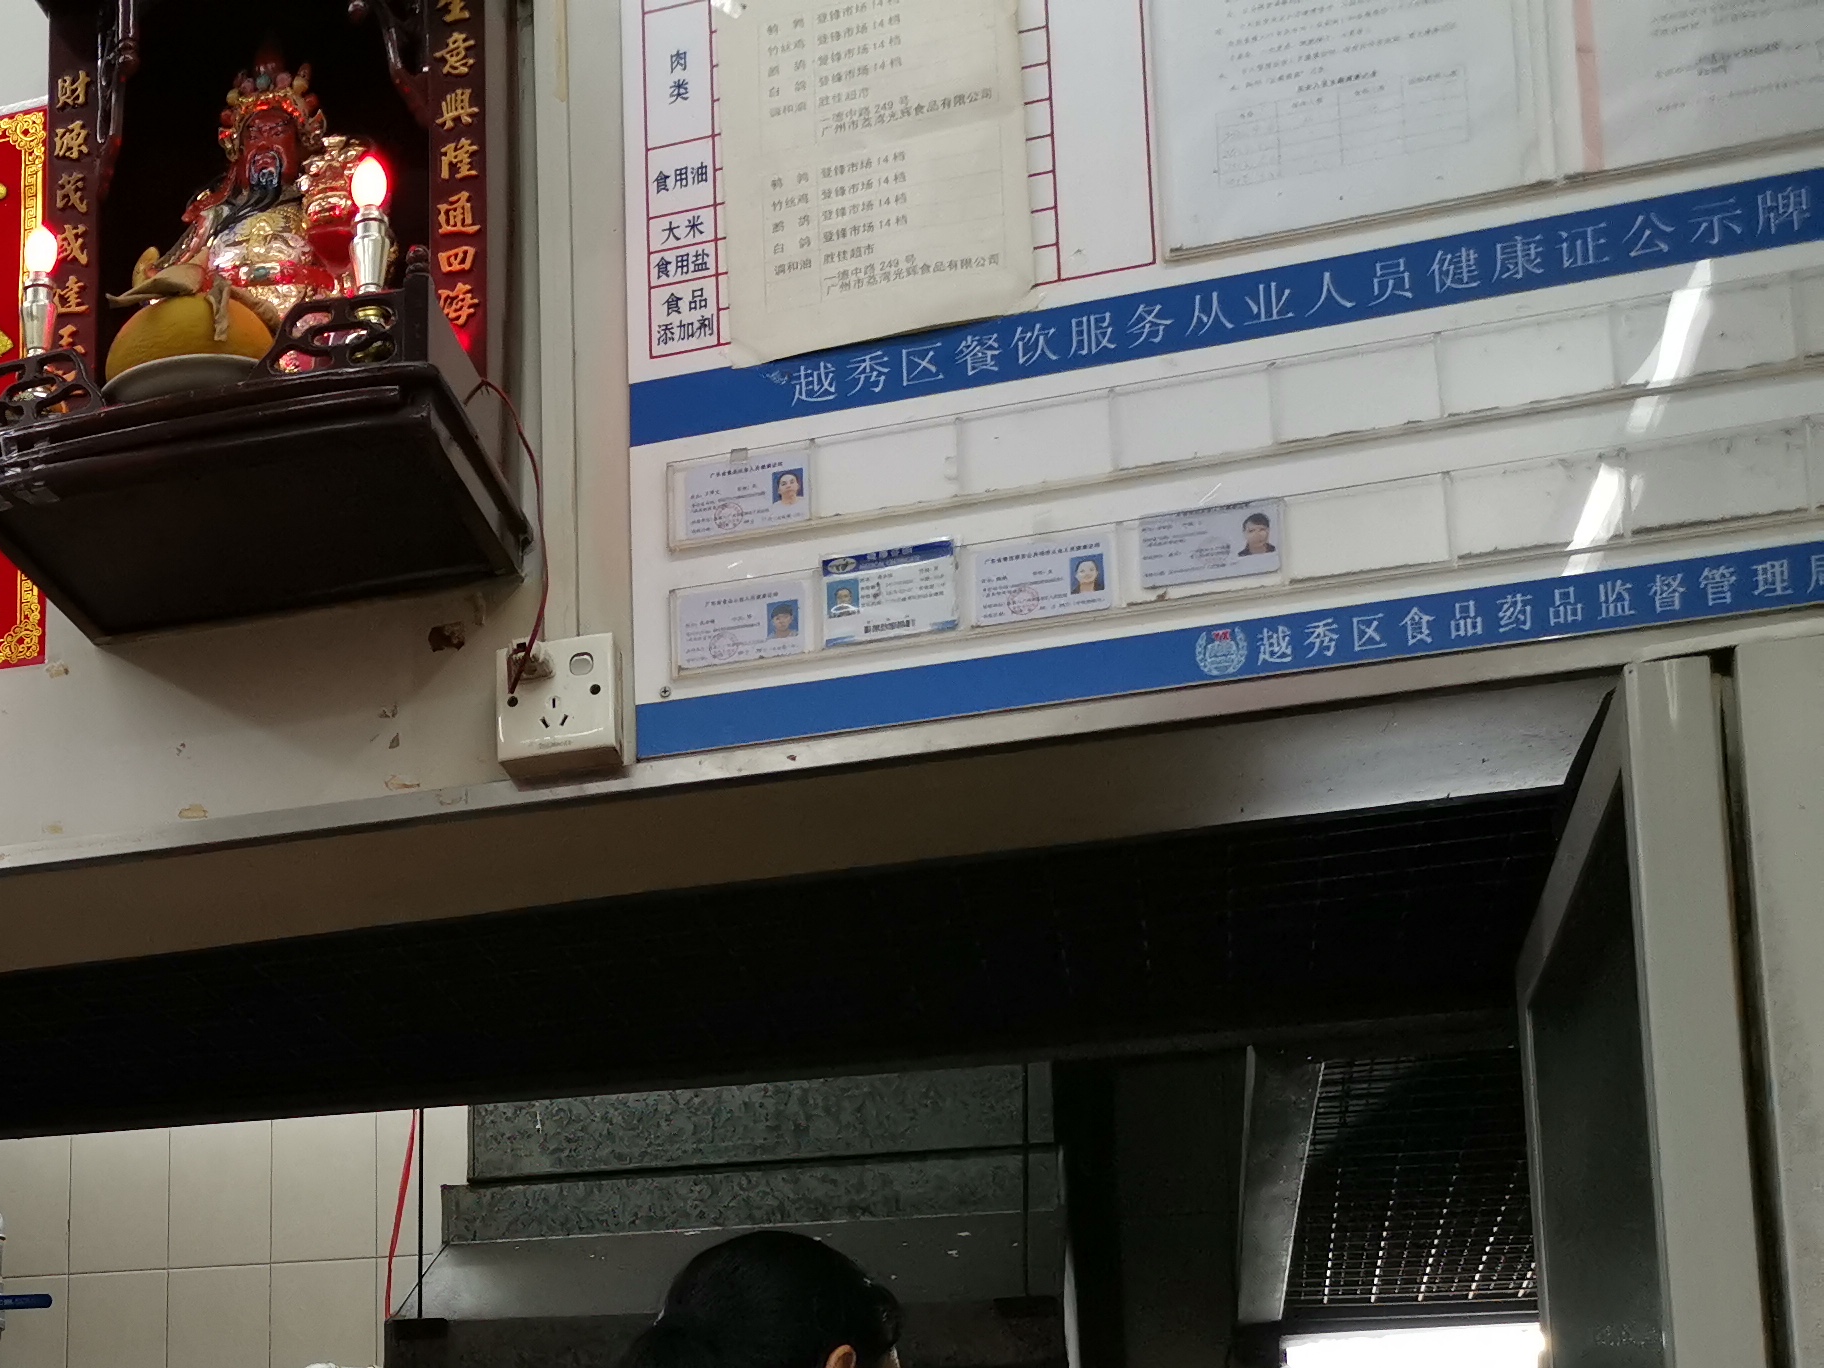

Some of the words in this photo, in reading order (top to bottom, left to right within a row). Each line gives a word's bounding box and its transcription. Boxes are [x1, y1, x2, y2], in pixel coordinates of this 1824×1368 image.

[669, 49, 690, 105] 肉类
[652, 163, 709, 194] 食用油
[661, 215, 705, 243] 大米
[653, 249, 711, 281] 食用盐
[662, 287, 709, 314] 食品
[790, 184, 1812, 407] 越秀区餐饮服务从业人员健康证公示牌
[657, 314, 715, 347] 添加剂
